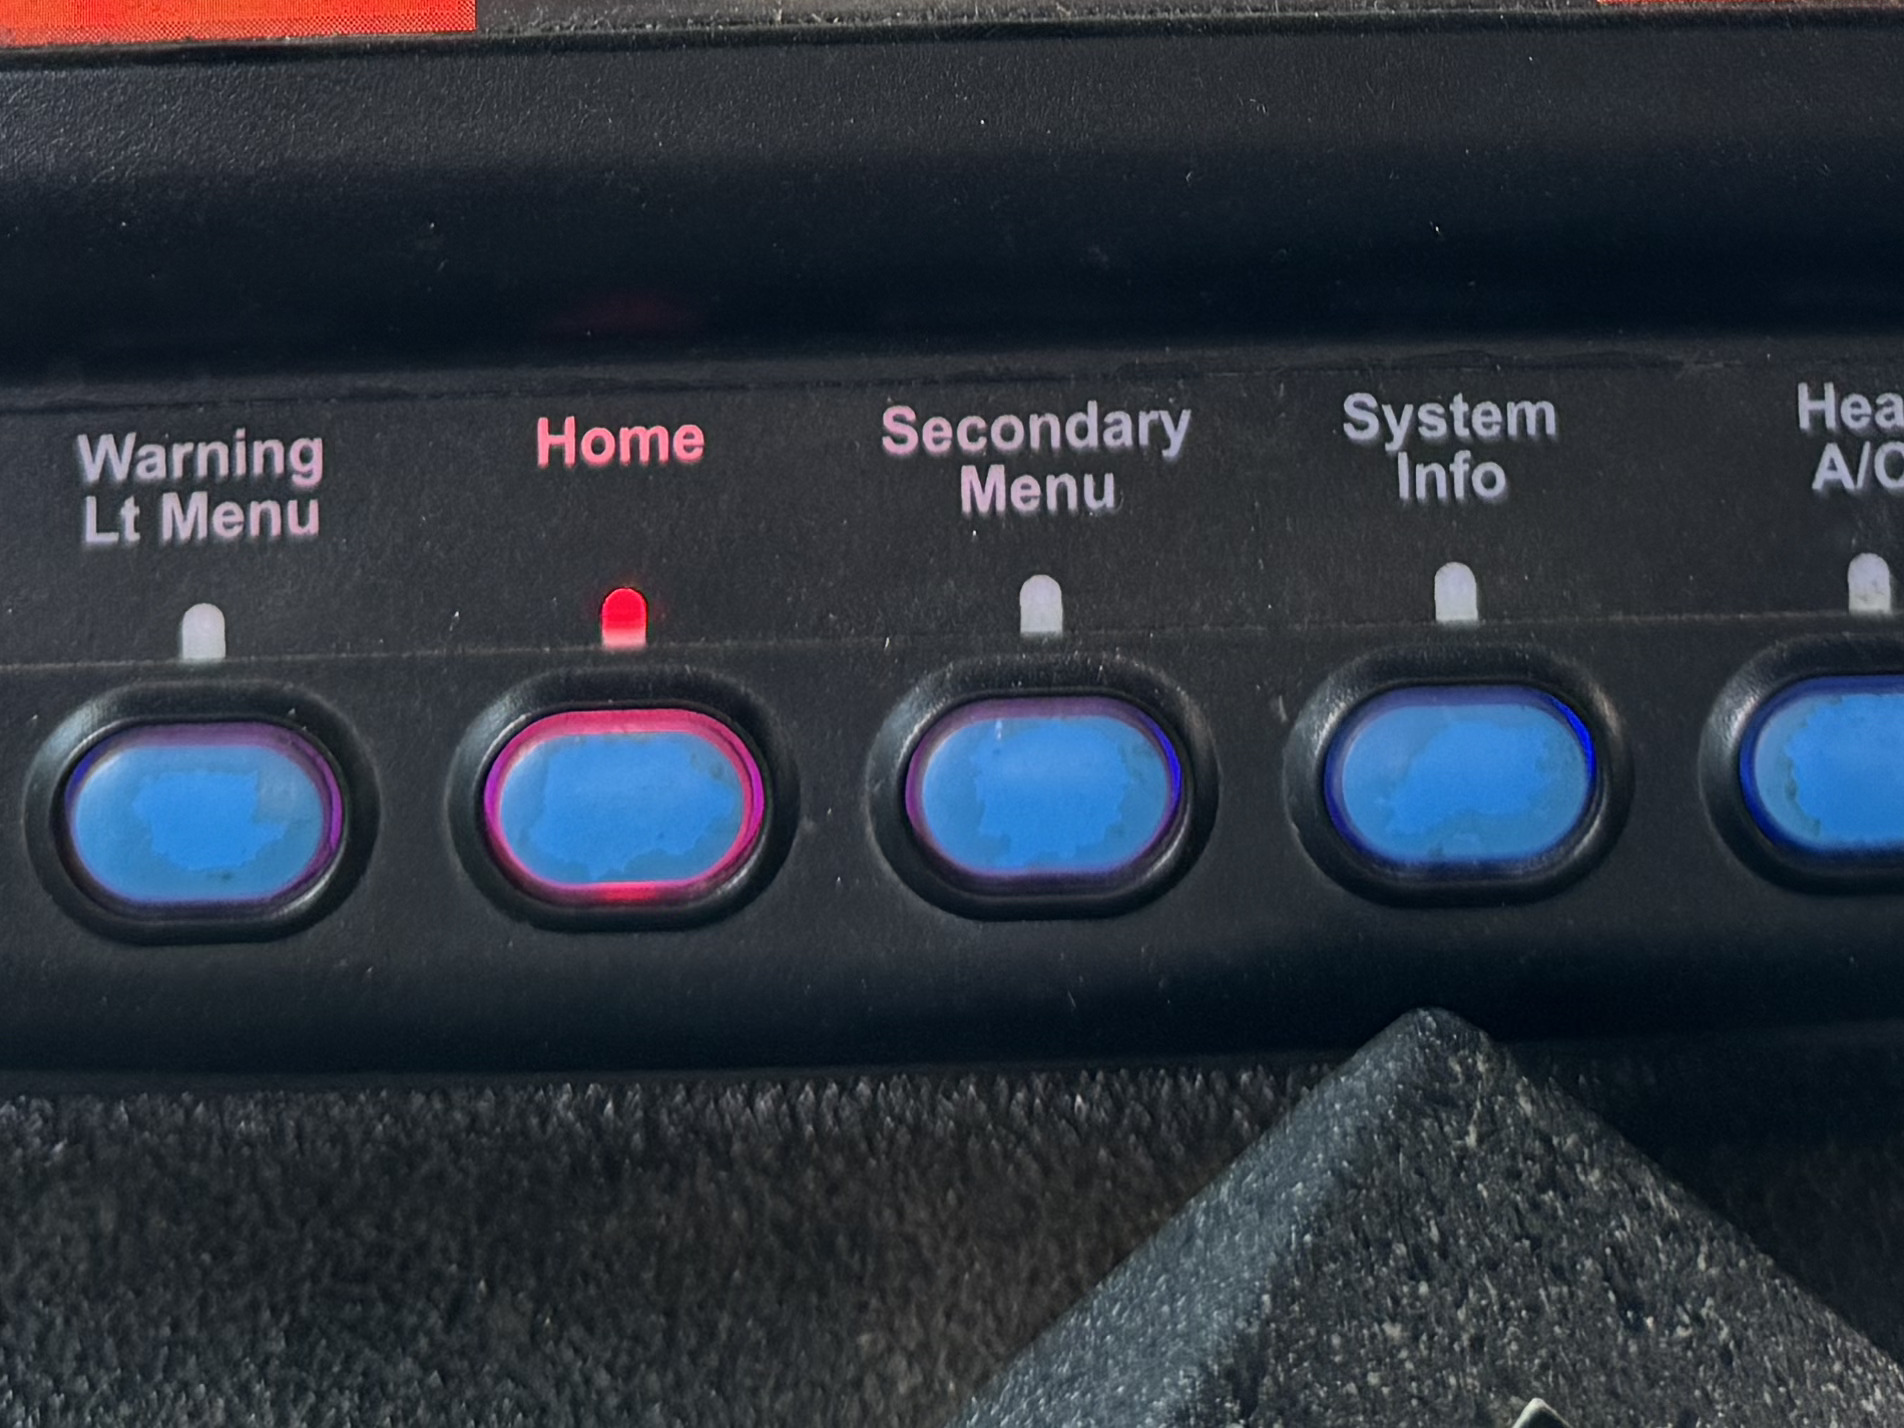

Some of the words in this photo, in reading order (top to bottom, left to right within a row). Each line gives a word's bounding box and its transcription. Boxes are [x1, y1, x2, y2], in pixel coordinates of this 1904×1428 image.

[535, 414, 706, 470] Home
[880, 399, 1193, 461] Secondary
[1342, 391, 1558, 454] System
[75, 427, 324, 490] Warning
[1396, 448, 1508, 502] Info
[959, 463, 1116, 516] Menu
[82, 494, 142, 548] Lt
[160, 490, 321, 544] Menu
